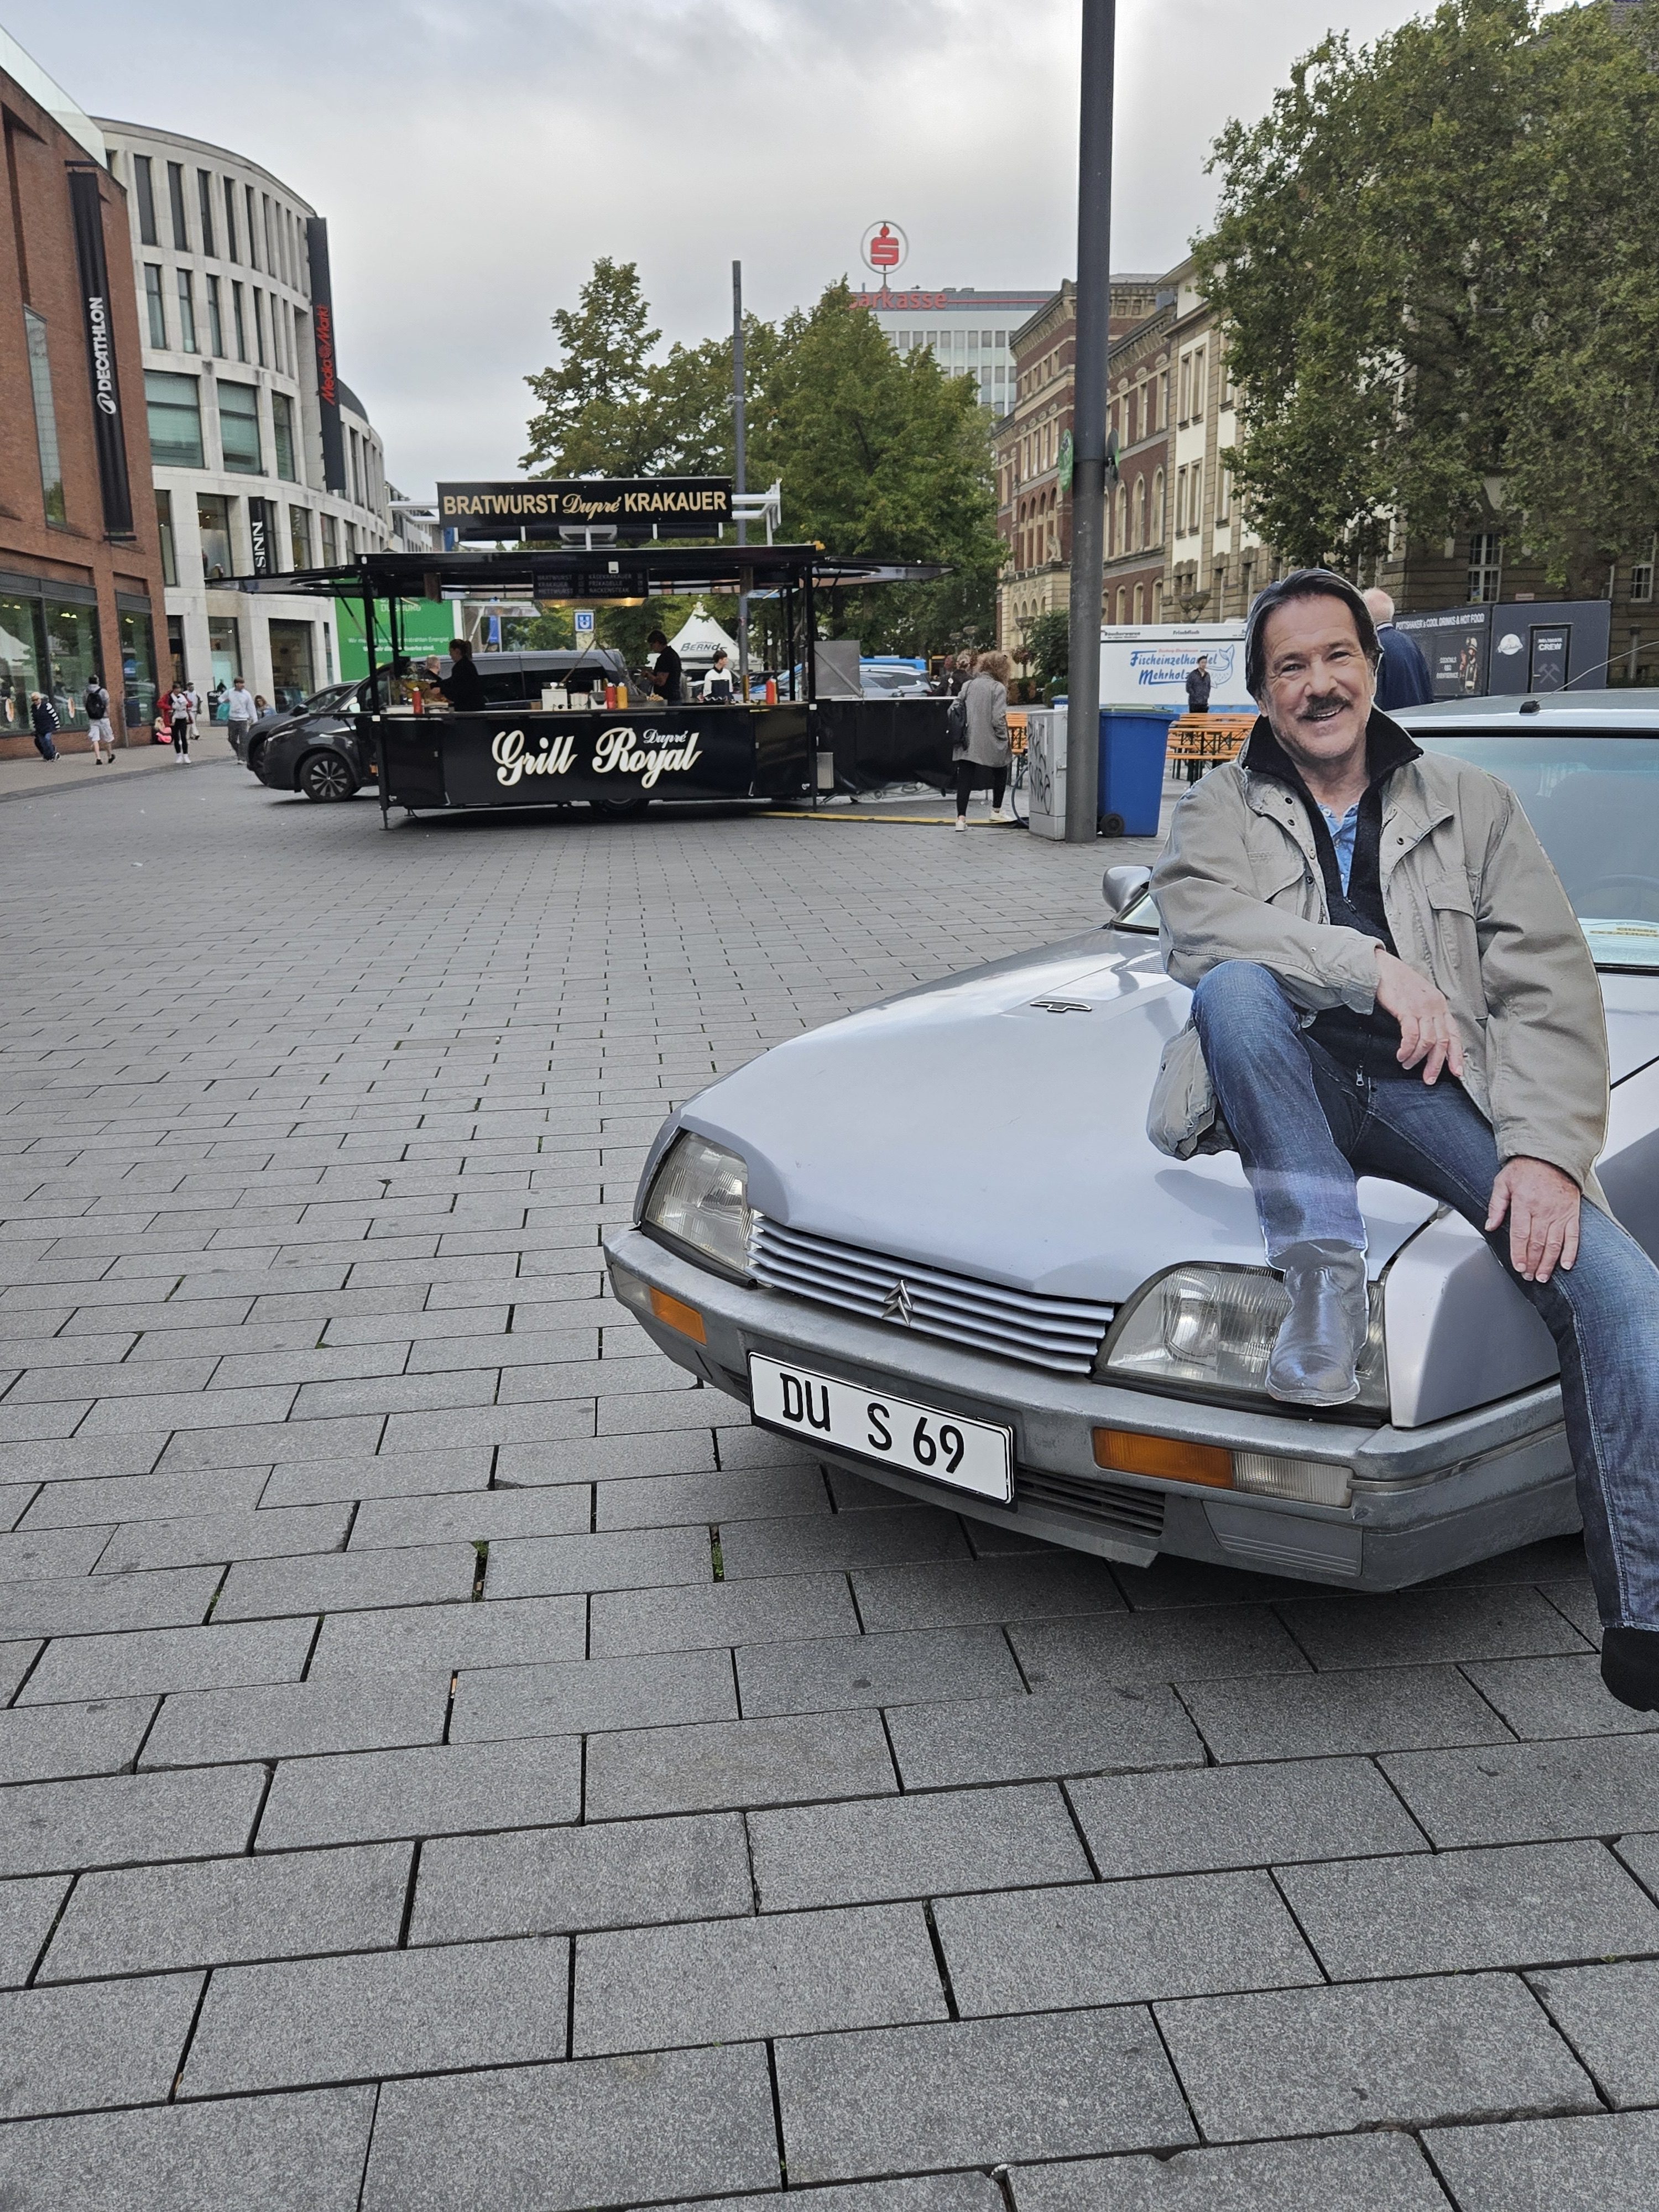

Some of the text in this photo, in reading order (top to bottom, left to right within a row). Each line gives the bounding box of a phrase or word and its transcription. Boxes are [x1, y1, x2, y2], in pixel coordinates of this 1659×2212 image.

[89, 297, 112, 391] DECATHLON
[443, 491, 727, 521] BRATWURST Dupré KRAKAUER
[252, 521, 267, 568] SINN
[1130, 651, 1218, 667] Fischeinzelhael
[492, 727, 703, 789] Grill Royal
[643, 728, 689, 749] Dupré
[780, 1372, 964, 1474] DU S 69
